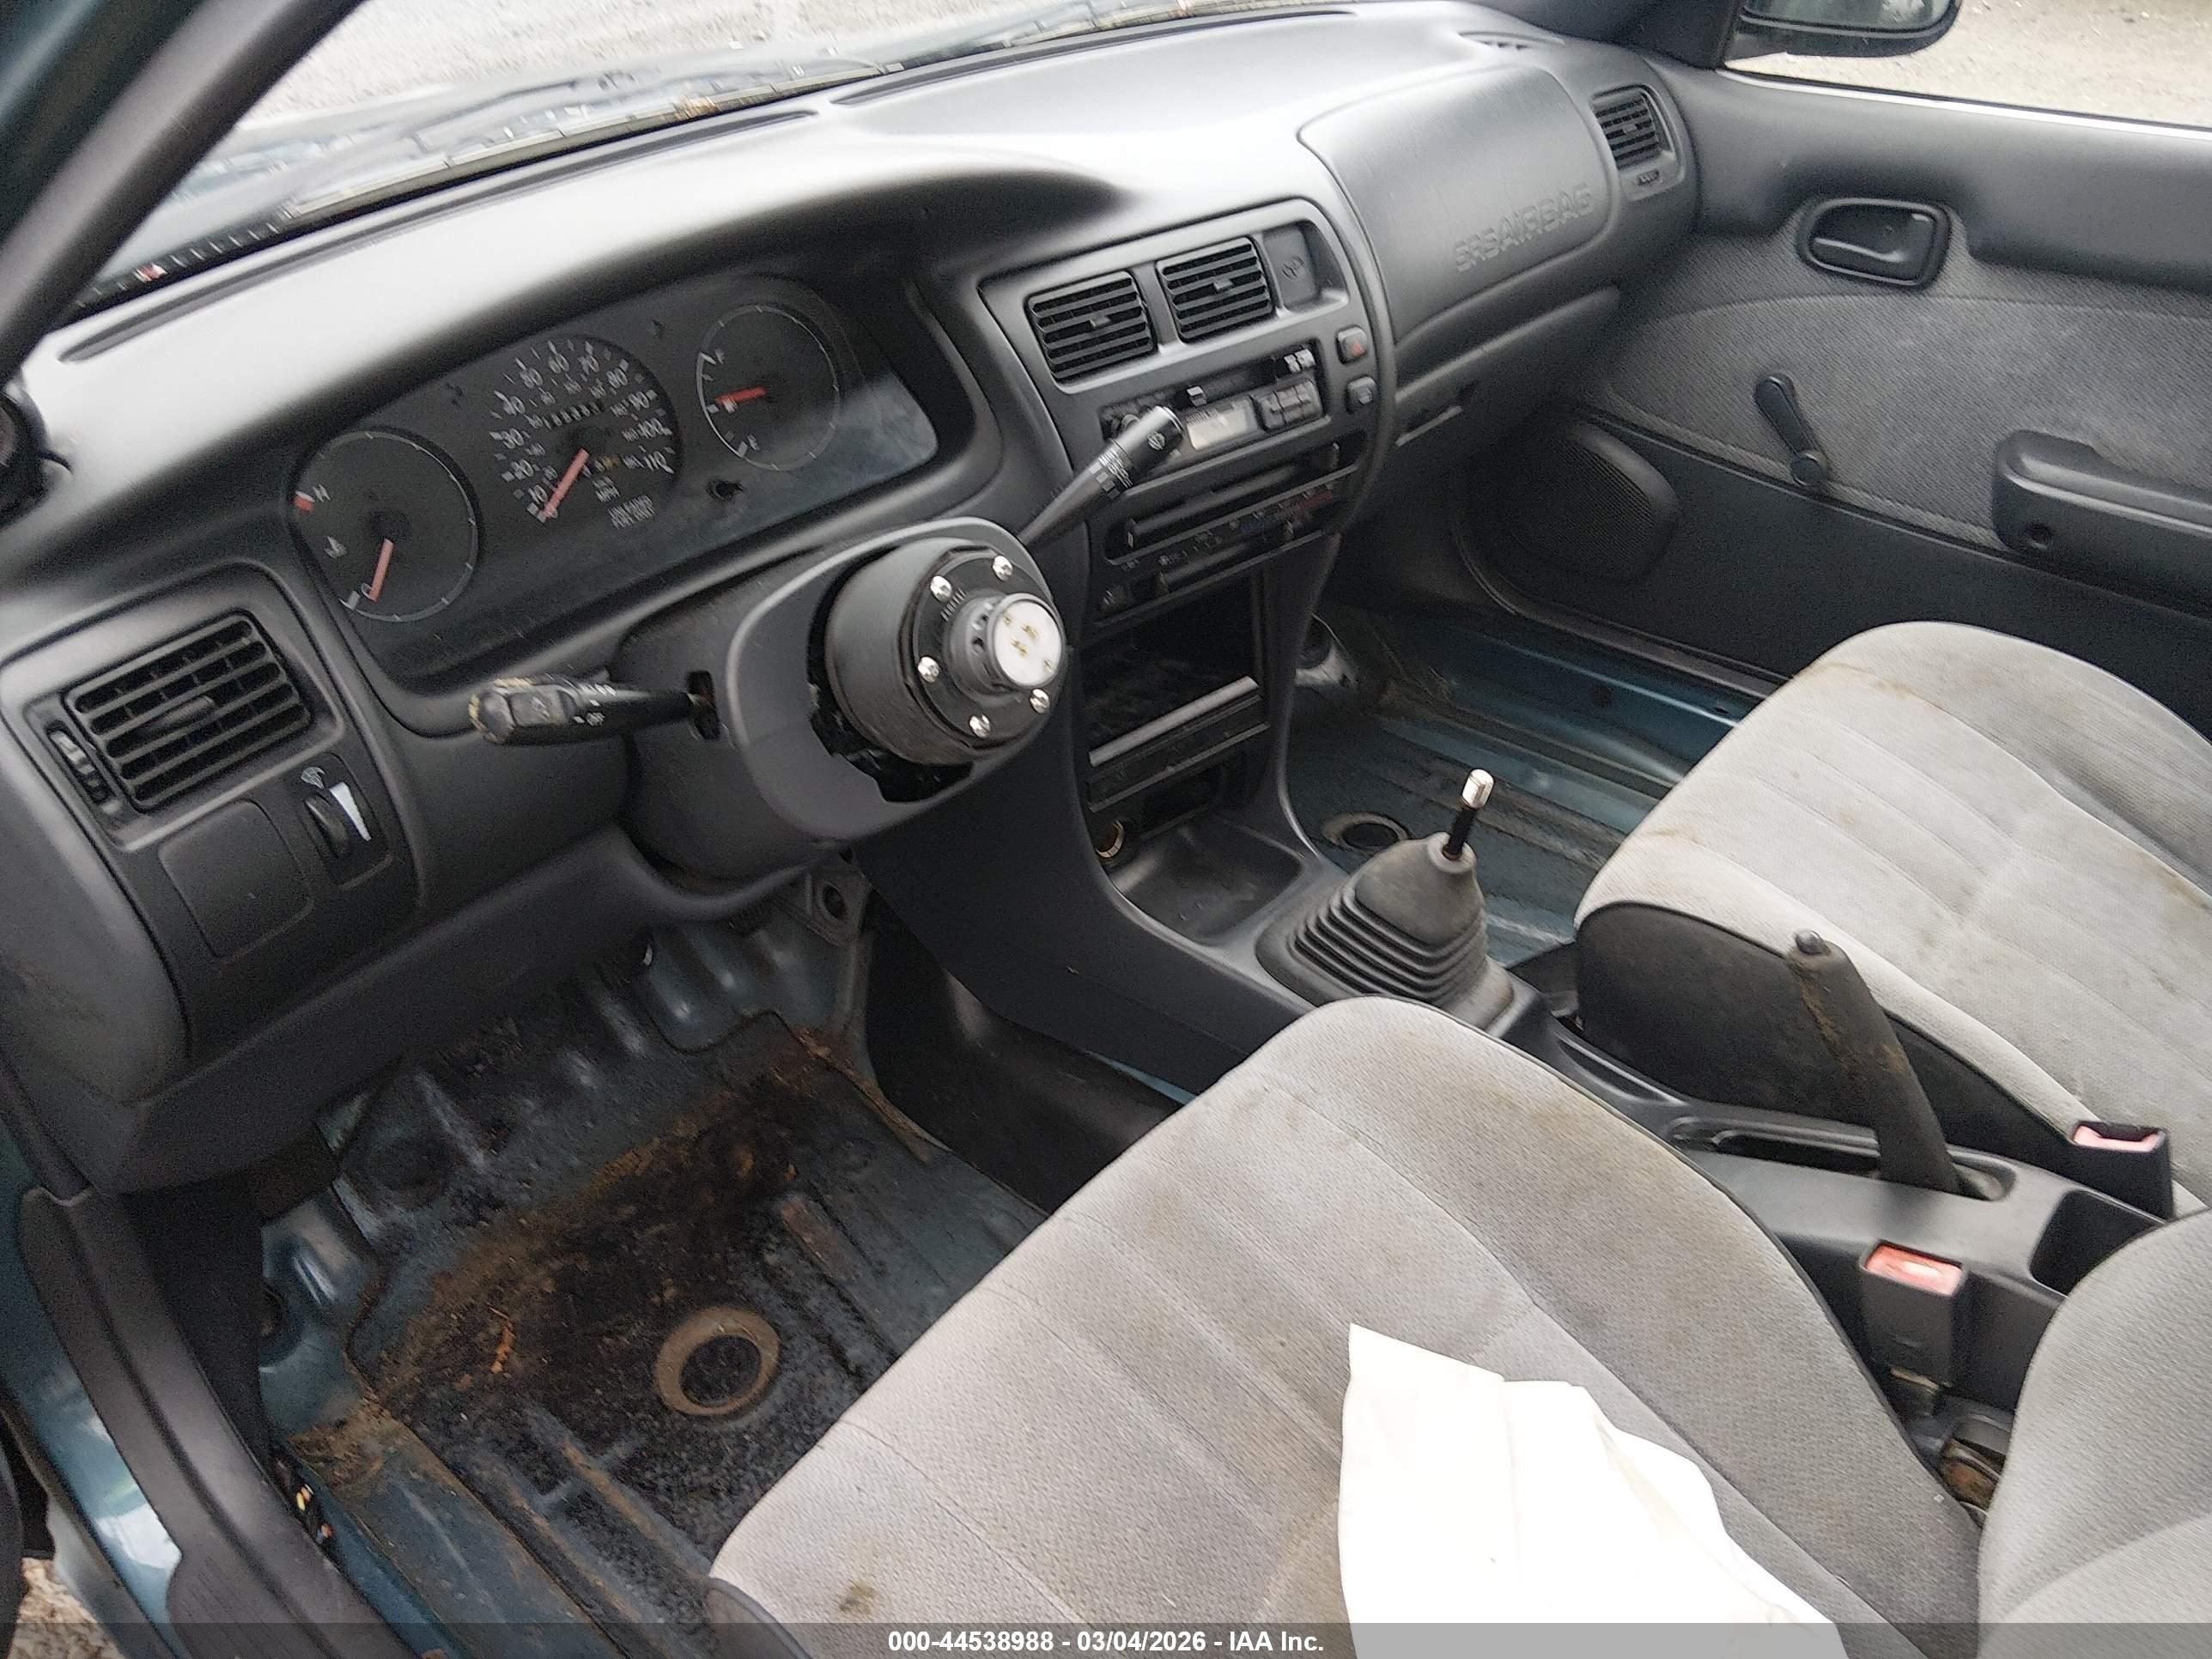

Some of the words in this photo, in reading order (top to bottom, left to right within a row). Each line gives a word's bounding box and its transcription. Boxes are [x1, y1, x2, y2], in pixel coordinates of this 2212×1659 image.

[1455, 227, 1499, 273] SRS
[1500, 182, 1595, 251] AIRBAG
[548, 353, 570, 374] 60
